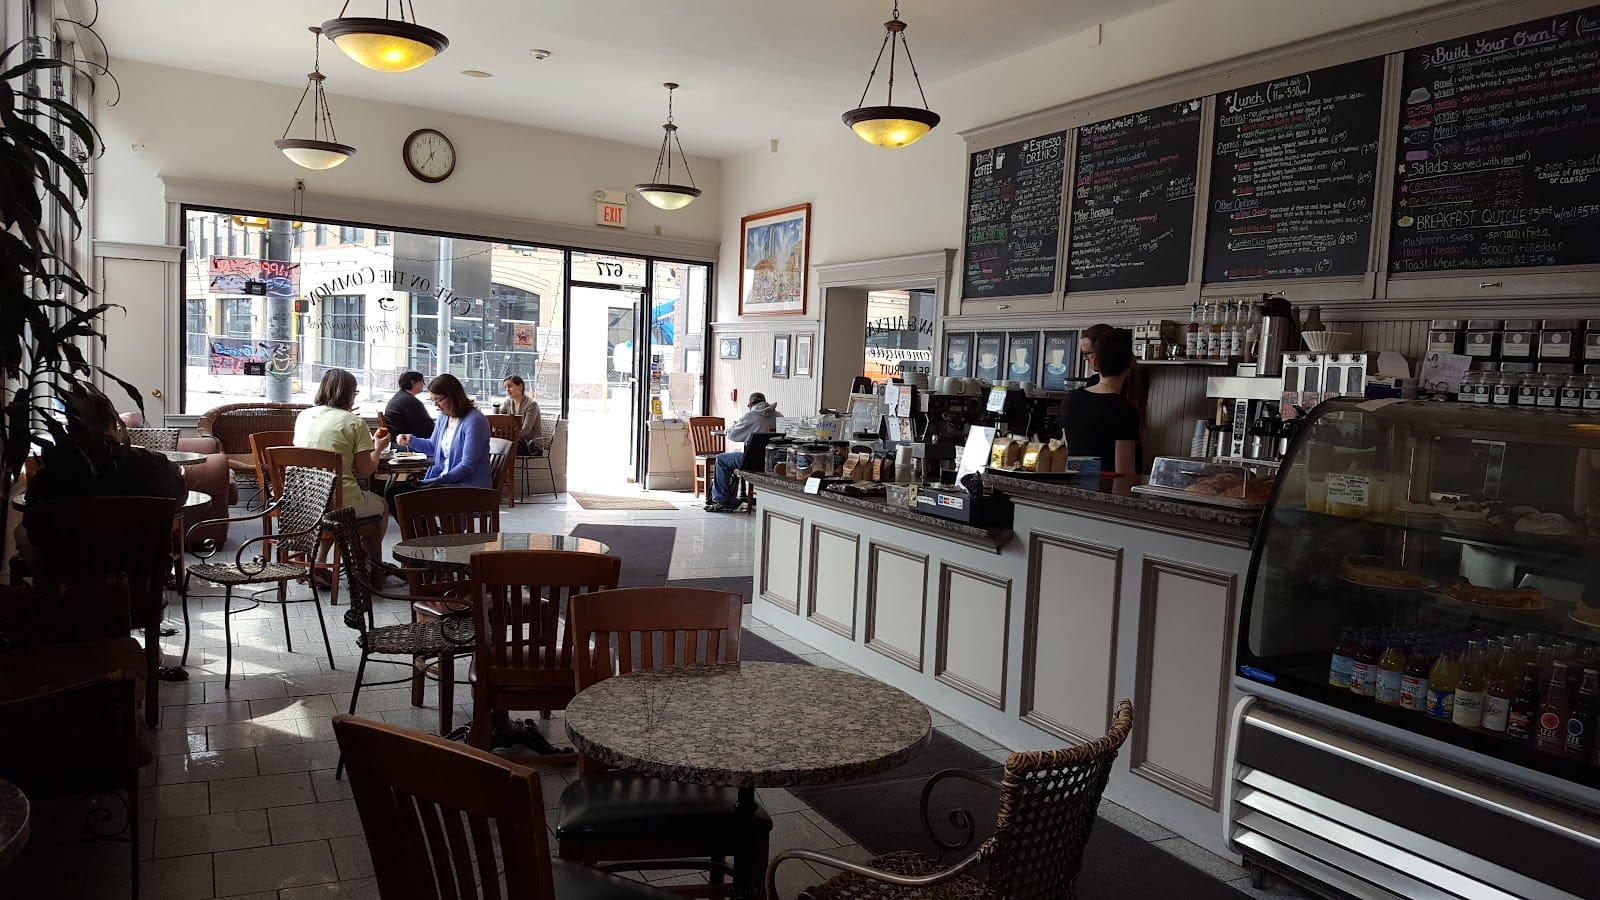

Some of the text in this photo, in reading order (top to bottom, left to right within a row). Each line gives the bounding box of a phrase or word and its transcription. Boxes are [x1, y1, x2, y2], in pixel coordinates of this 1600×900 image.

[1431, 19, 1559, 64] Build Your Own!
[1228, 91, 1264, 113] Lunch
[1026, 147, 1058, 165] DRINKS
[974, 163, 993, 178] COFFEE
[1408, 157, 1449, 178] Salads
[1482, 155, 1500, 168] with
[1562, 166, 1572, 177] of
[1549, 174, 1592, 185] or caesar
[604, 205, 623, 224] EXIT
[1214, 199, 1234, 213] Other
[1416, 208, 1479, 231] BREAKFAST
[1481, 207, 1528, 224] QUICHE
[1540, 728, 1557, 738] IZZE
